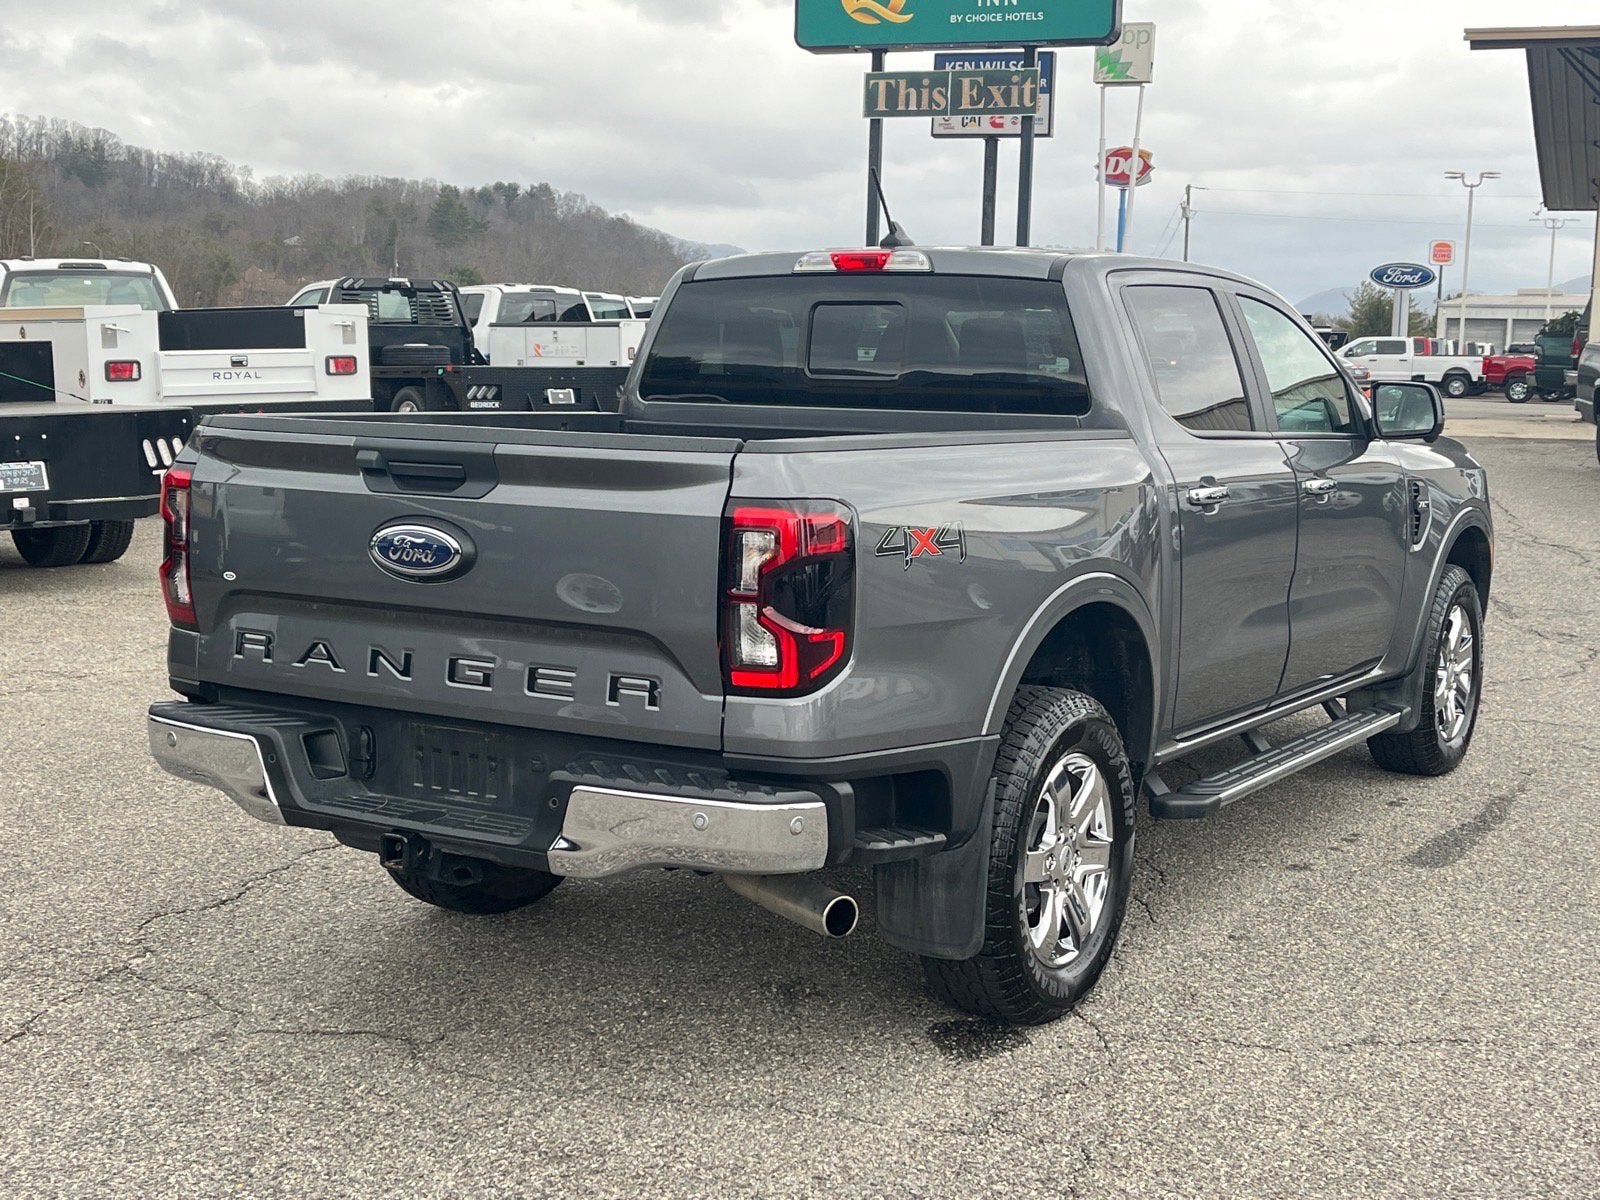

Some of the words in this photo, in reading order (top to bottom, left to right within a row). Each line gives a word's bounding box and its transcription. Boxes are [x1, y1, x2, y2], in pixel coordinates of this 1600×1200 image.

[950, 14, 963, 23] BY
[965, 13, 1003, 23] CHOICE
[1005, 11, 1044, 21] HOTELS
[1121, 25, 1151, 49] bp
[869, 78, 947, 112] This
[958, 74, 1036, 110] Exit
[1382, 266, 1422, 284] Ford
[212, 370, 263, 381] ROYAL
[388, 534, 437, 564] Ford
[232, 626, 664, 712] RANGER
[1089, 725, 1135, 827] GOODYEAR
